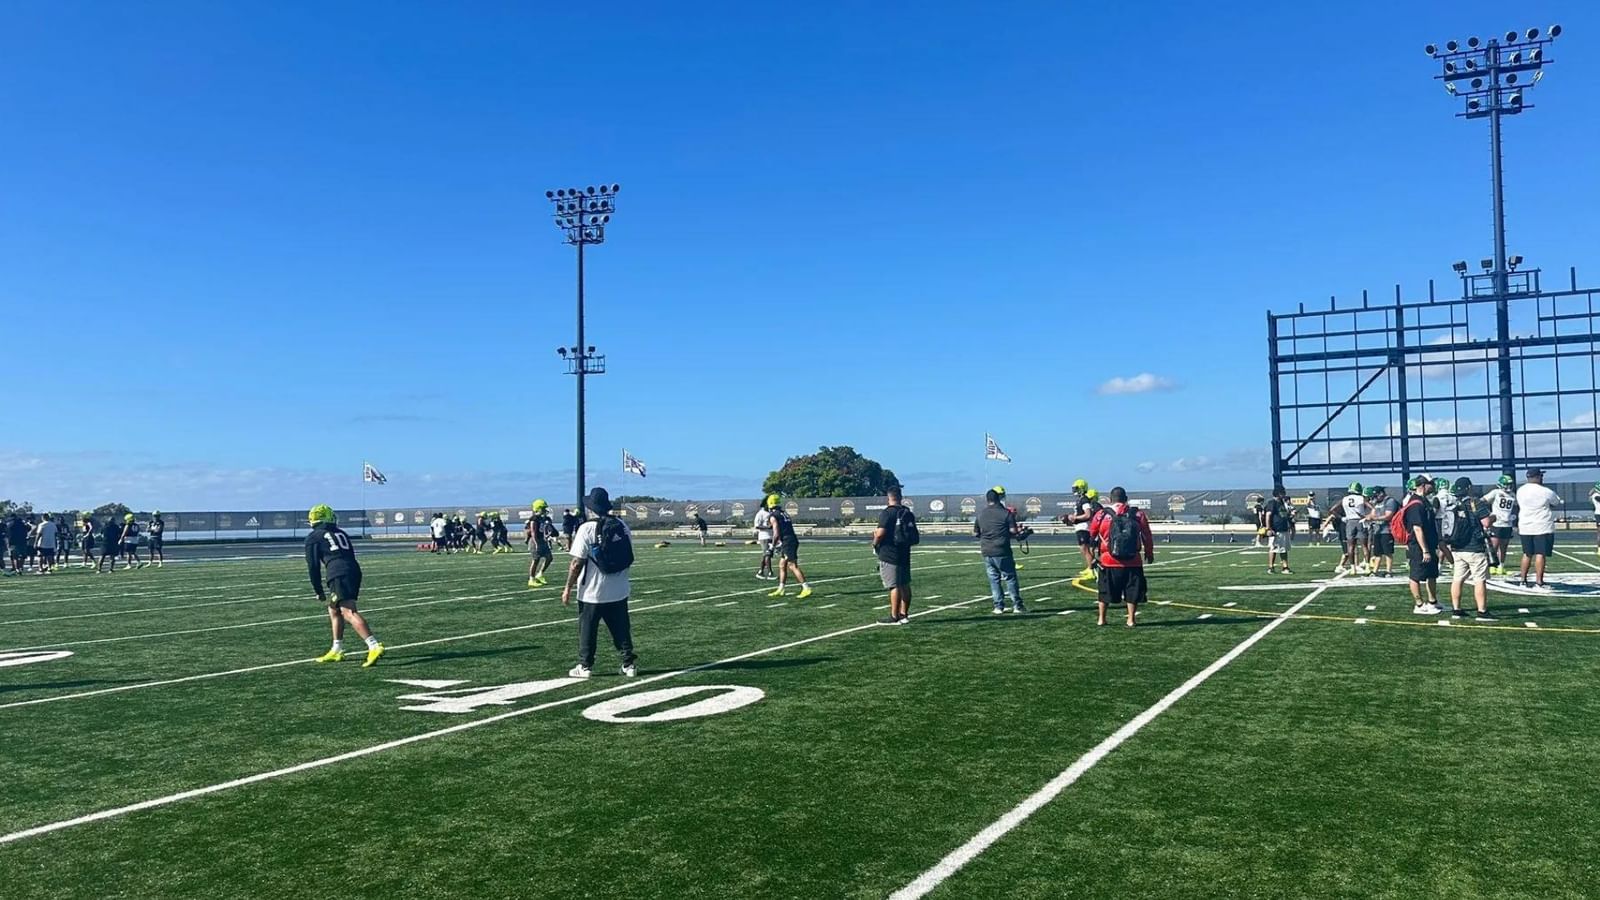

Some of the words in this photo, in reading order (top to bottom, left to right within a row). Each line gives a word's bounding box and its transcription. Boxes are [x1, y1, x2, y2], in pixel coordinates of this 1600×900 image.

[1348, 498, 1356, 508] 2
[1499, 498, 1513, 510] 88
[323, 531, 350, 552] 10
